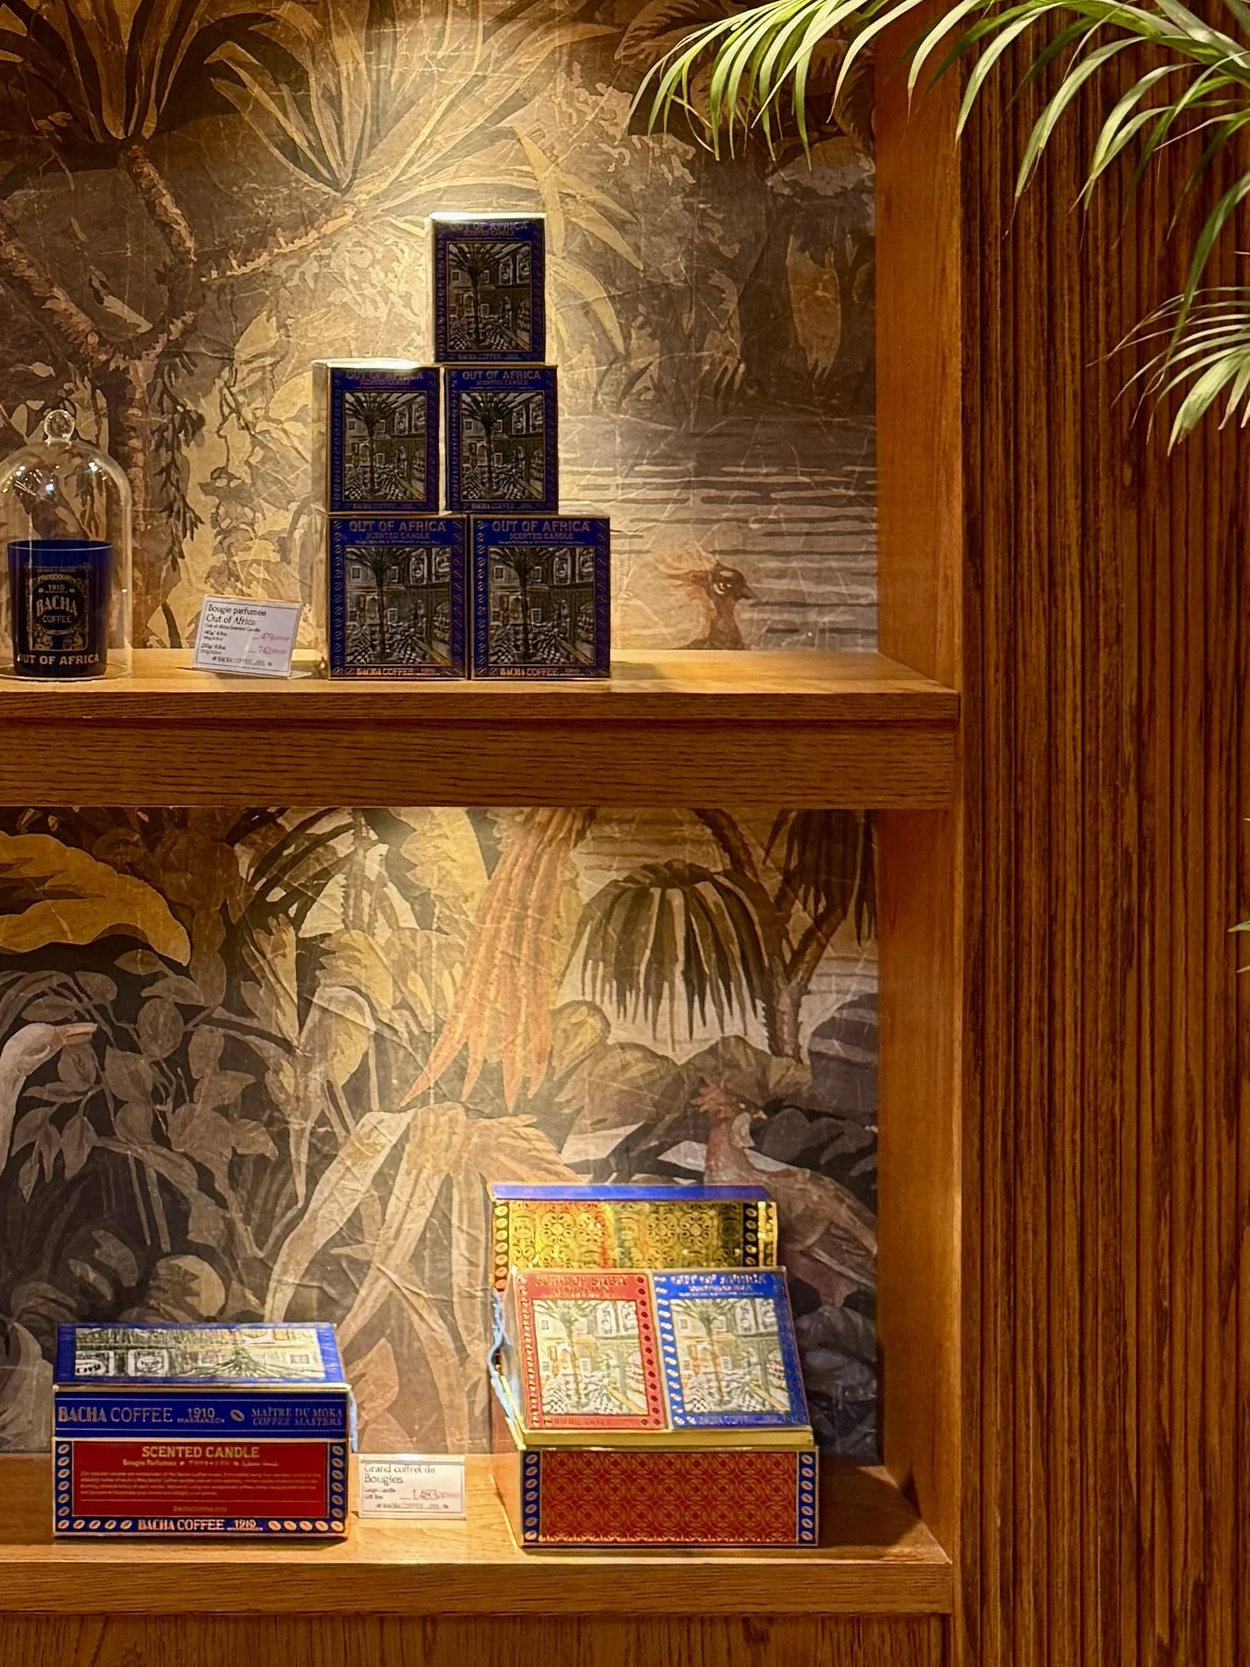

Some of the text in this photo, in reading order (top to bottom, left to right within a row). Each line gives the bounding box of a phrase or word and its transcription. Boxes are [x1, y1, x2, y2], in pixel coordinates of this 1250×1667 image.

[462, 371, 541, 380] OUT OF AFRICA
[349, 521, 447, 532] OUT OF AFRICA
[492, 521, 590, 532] OUT OF AFRICA
[36, 595, 78, 617] BACHA
[42, 615, 73, 623] COFFEE
[206, 614, 222, 623] Out
[223, 616, 232, 624] of
[39, 654, 99, 665] OF AFRICA
[57, 1407, 107, 1423] BACHA
[110, 1407, 173, 1423] COFFEE
[187, 1407, 215, 1419] 1910
[295, 1408, 310, 1417] DU
[312, 1408, 343, 1418] MOKA
[142, 1446, 260, 1458] SCENTED CANDLE
[137, 1519, 257, 1531] BACHA COFFEE 1910
